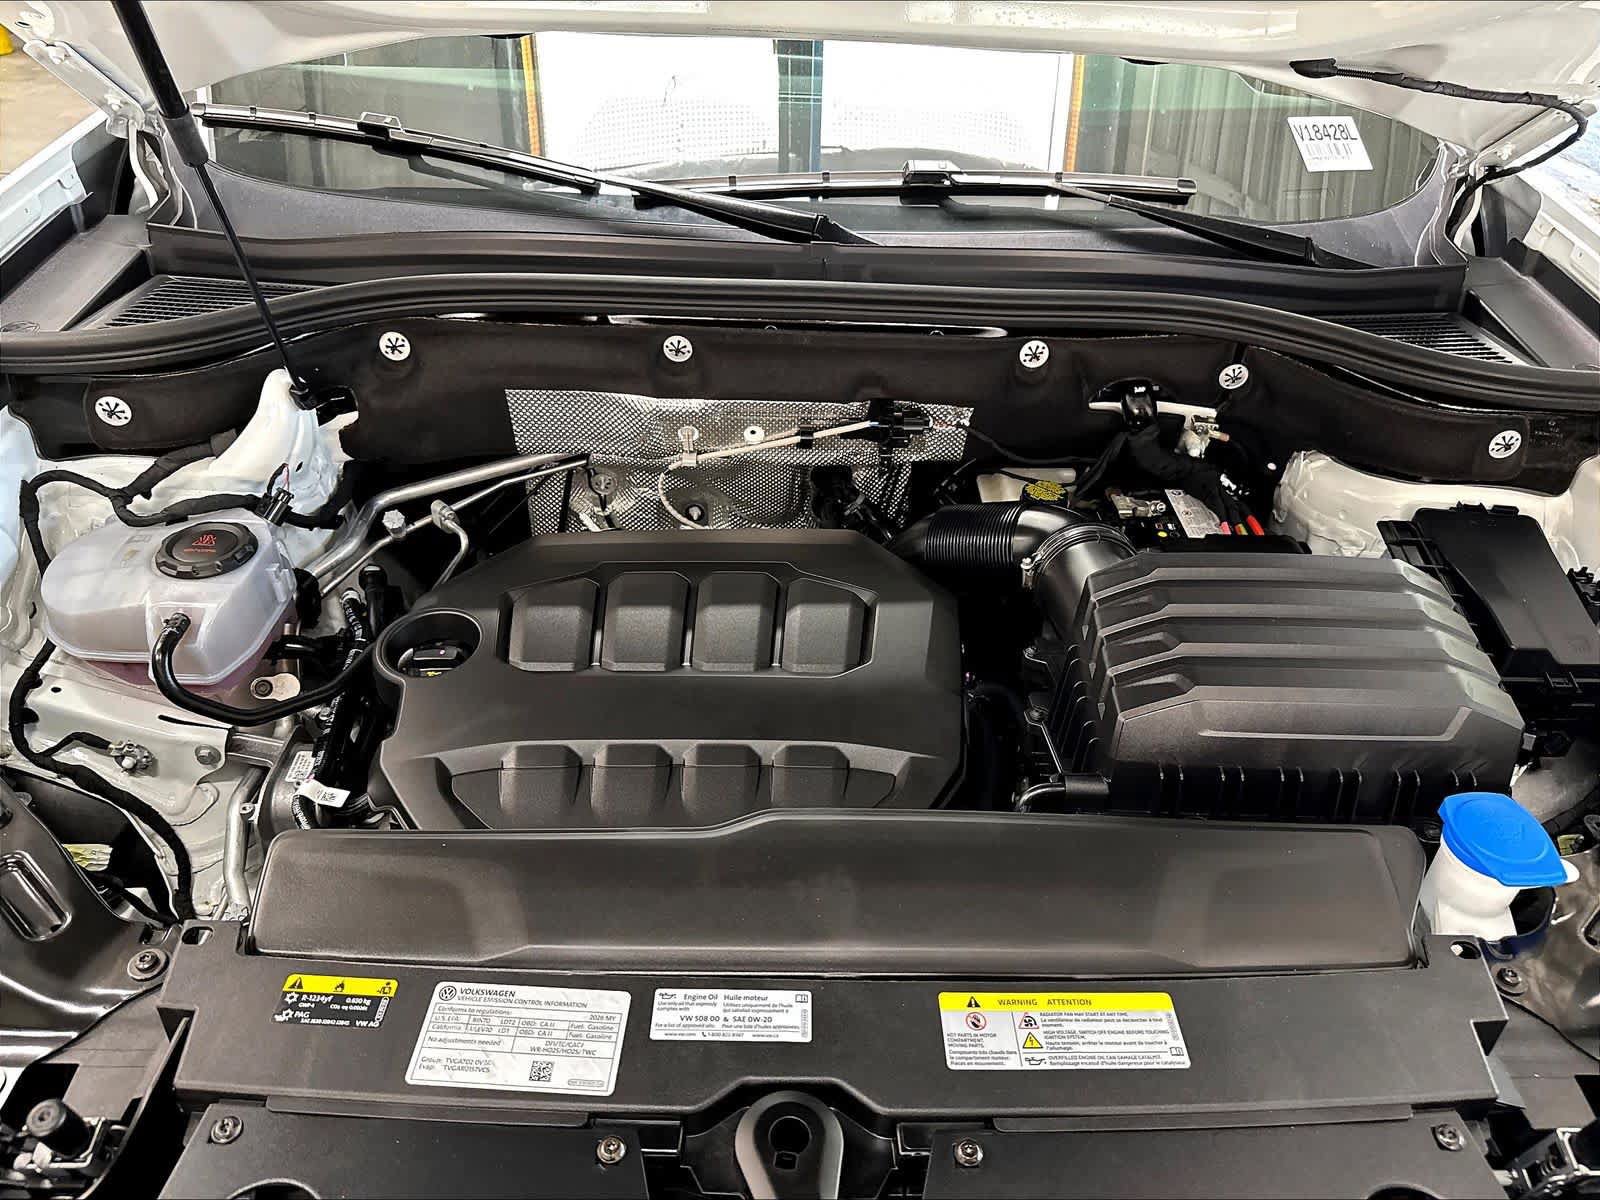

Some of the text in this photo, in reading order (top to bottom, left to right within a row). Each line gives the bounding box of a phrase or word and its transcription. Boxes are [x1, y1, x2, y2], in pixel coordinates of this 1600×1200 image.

[1293, 124, 1358, 141] V18428L
[460, 987, 516, 997] VOLKSWAGEN
[684, 993, 707, 1001] Engine
[483, 996, 513, 1004] EMISSION
[544, 1000, 588, 1008] INFORMATION
[997, 998, 1092, 1006] WARNING ATTENTION
[732, 1015, 745, 1023] SAE
[367, 1020, 380, 1028] AG
